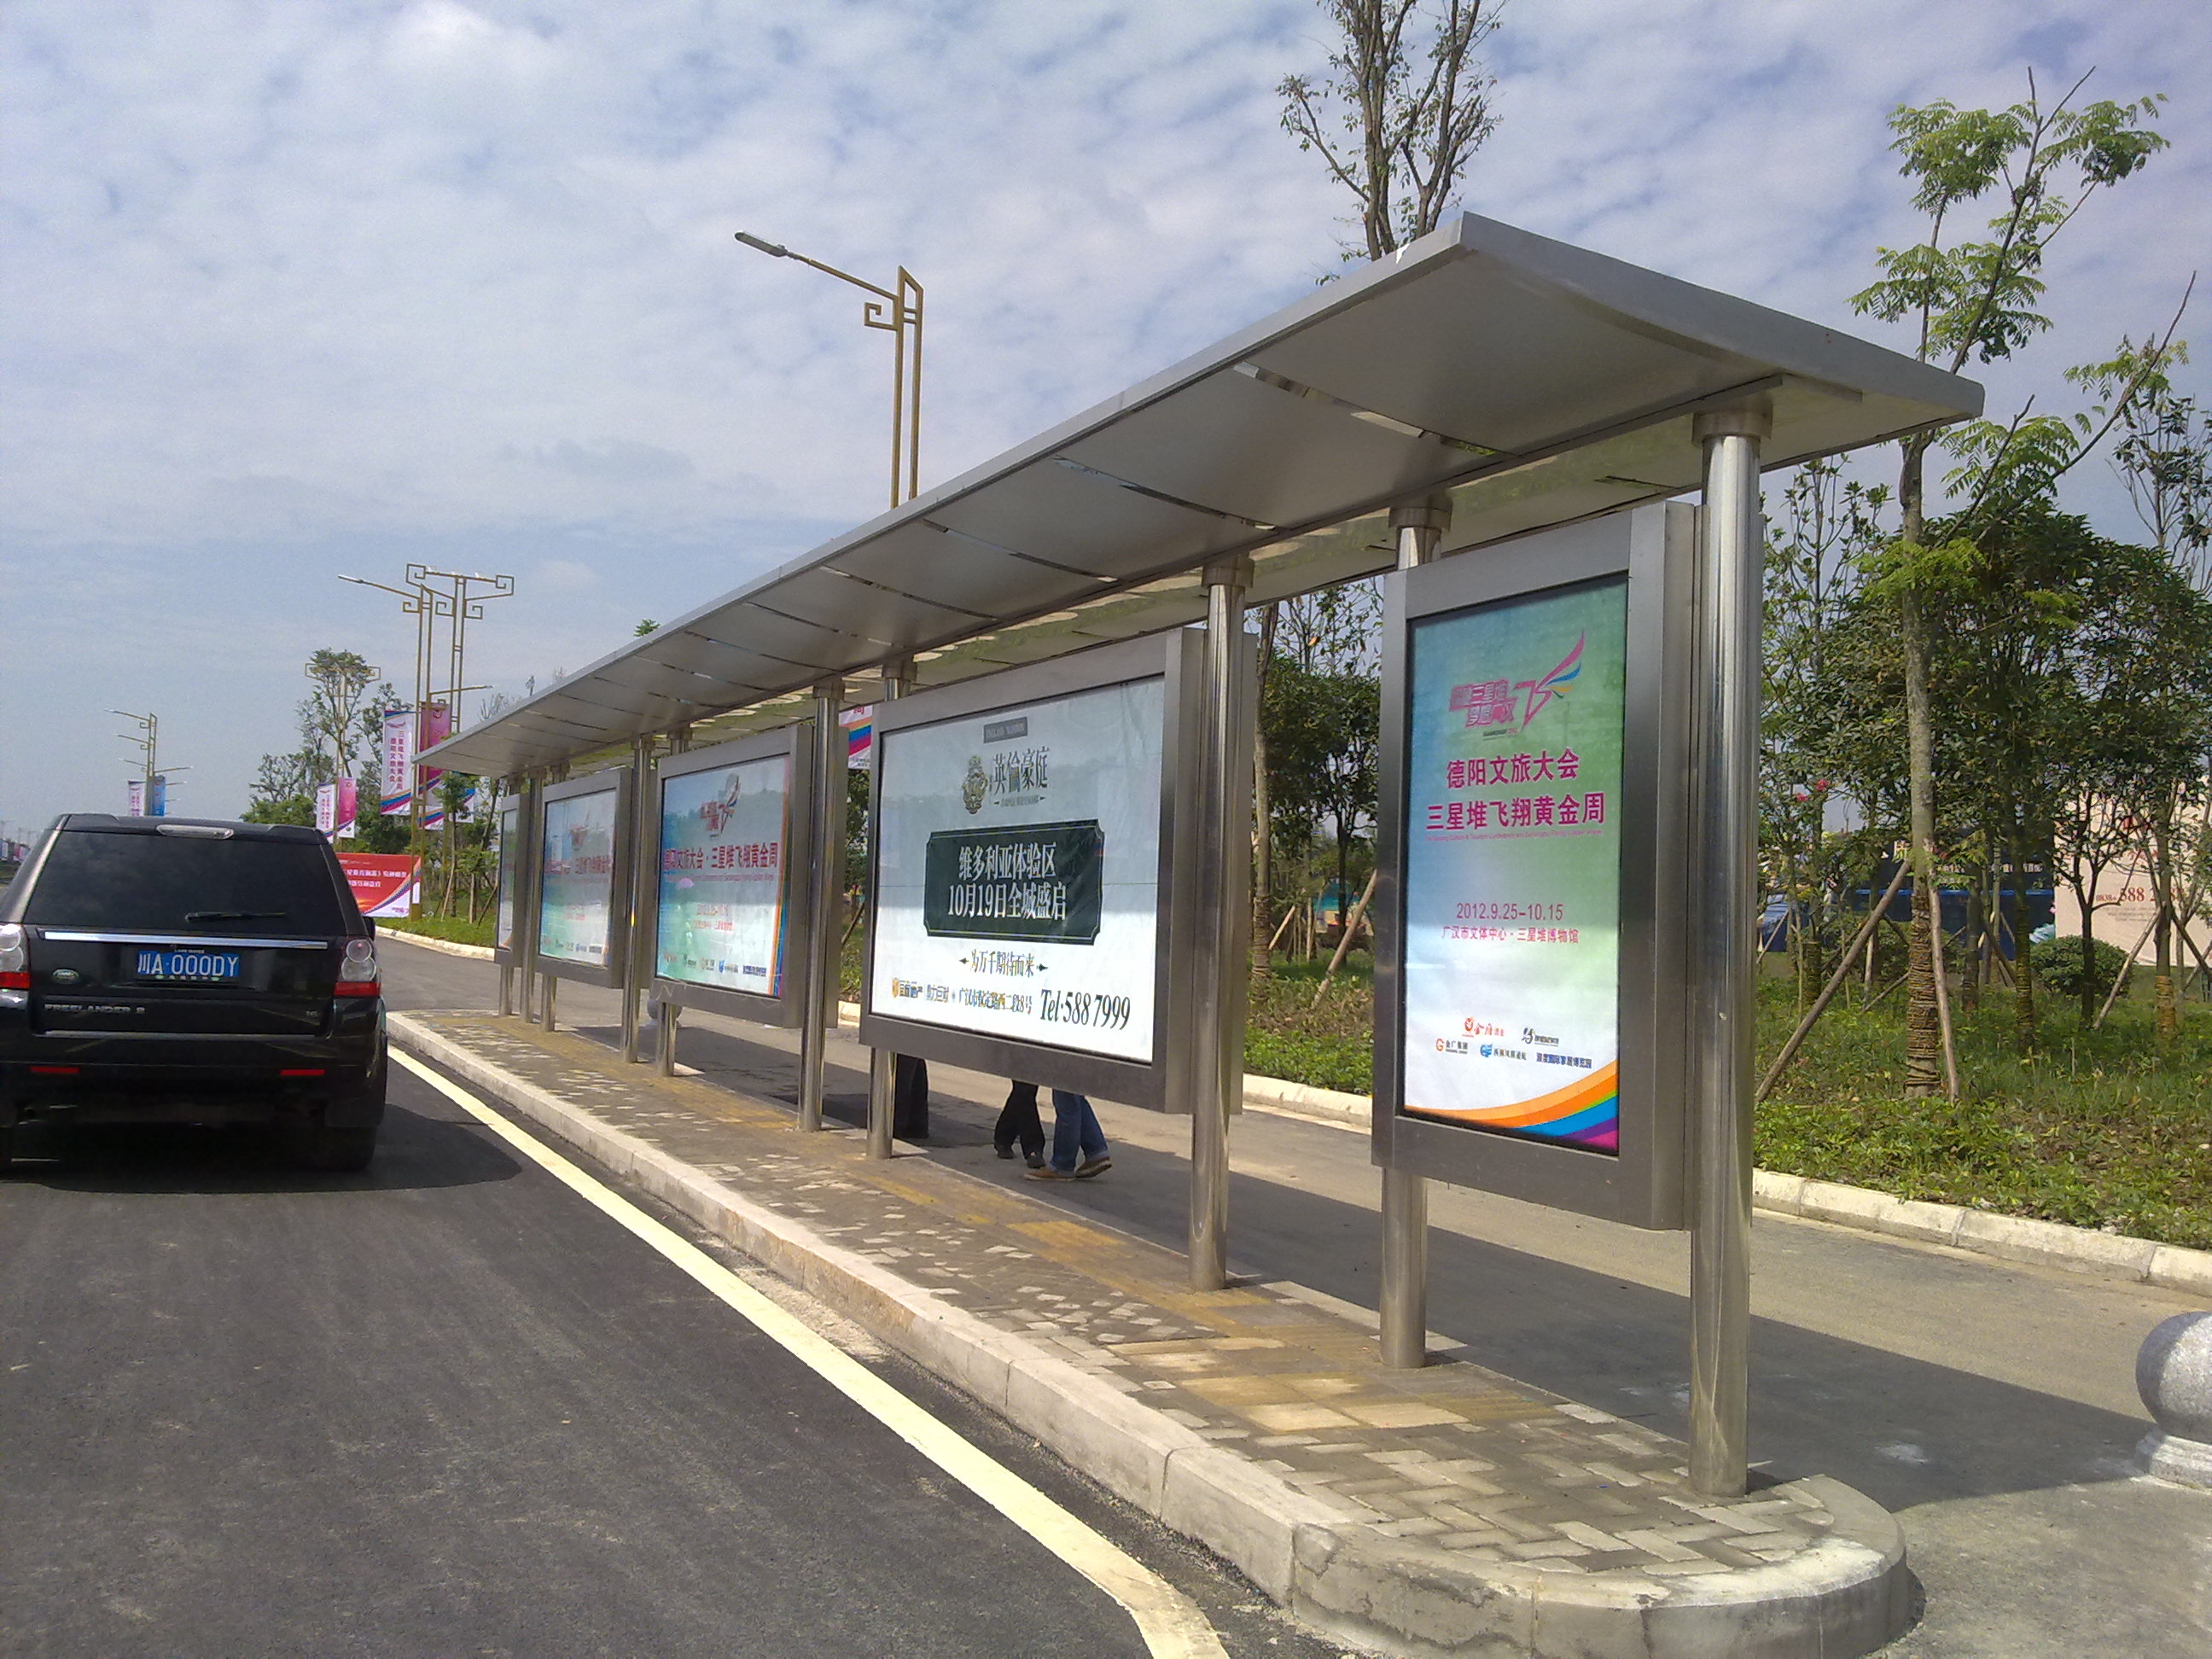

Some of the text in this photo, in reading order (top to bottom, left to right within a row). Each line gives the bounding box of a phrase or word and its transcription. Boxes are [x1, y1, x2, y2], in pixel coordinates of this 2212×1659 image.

[1447, 747, 1579, 789] 德阳文旅大会
[1426, 792, 1605, 830] 三星堆飞翔黄金周
[959, 841, 1059, 882] 维多利亚体验区
[947, 881, 1068, 921] 10月19日全城盛启
[1456, 902, 1563, 921] 2012.9.25-10.15
